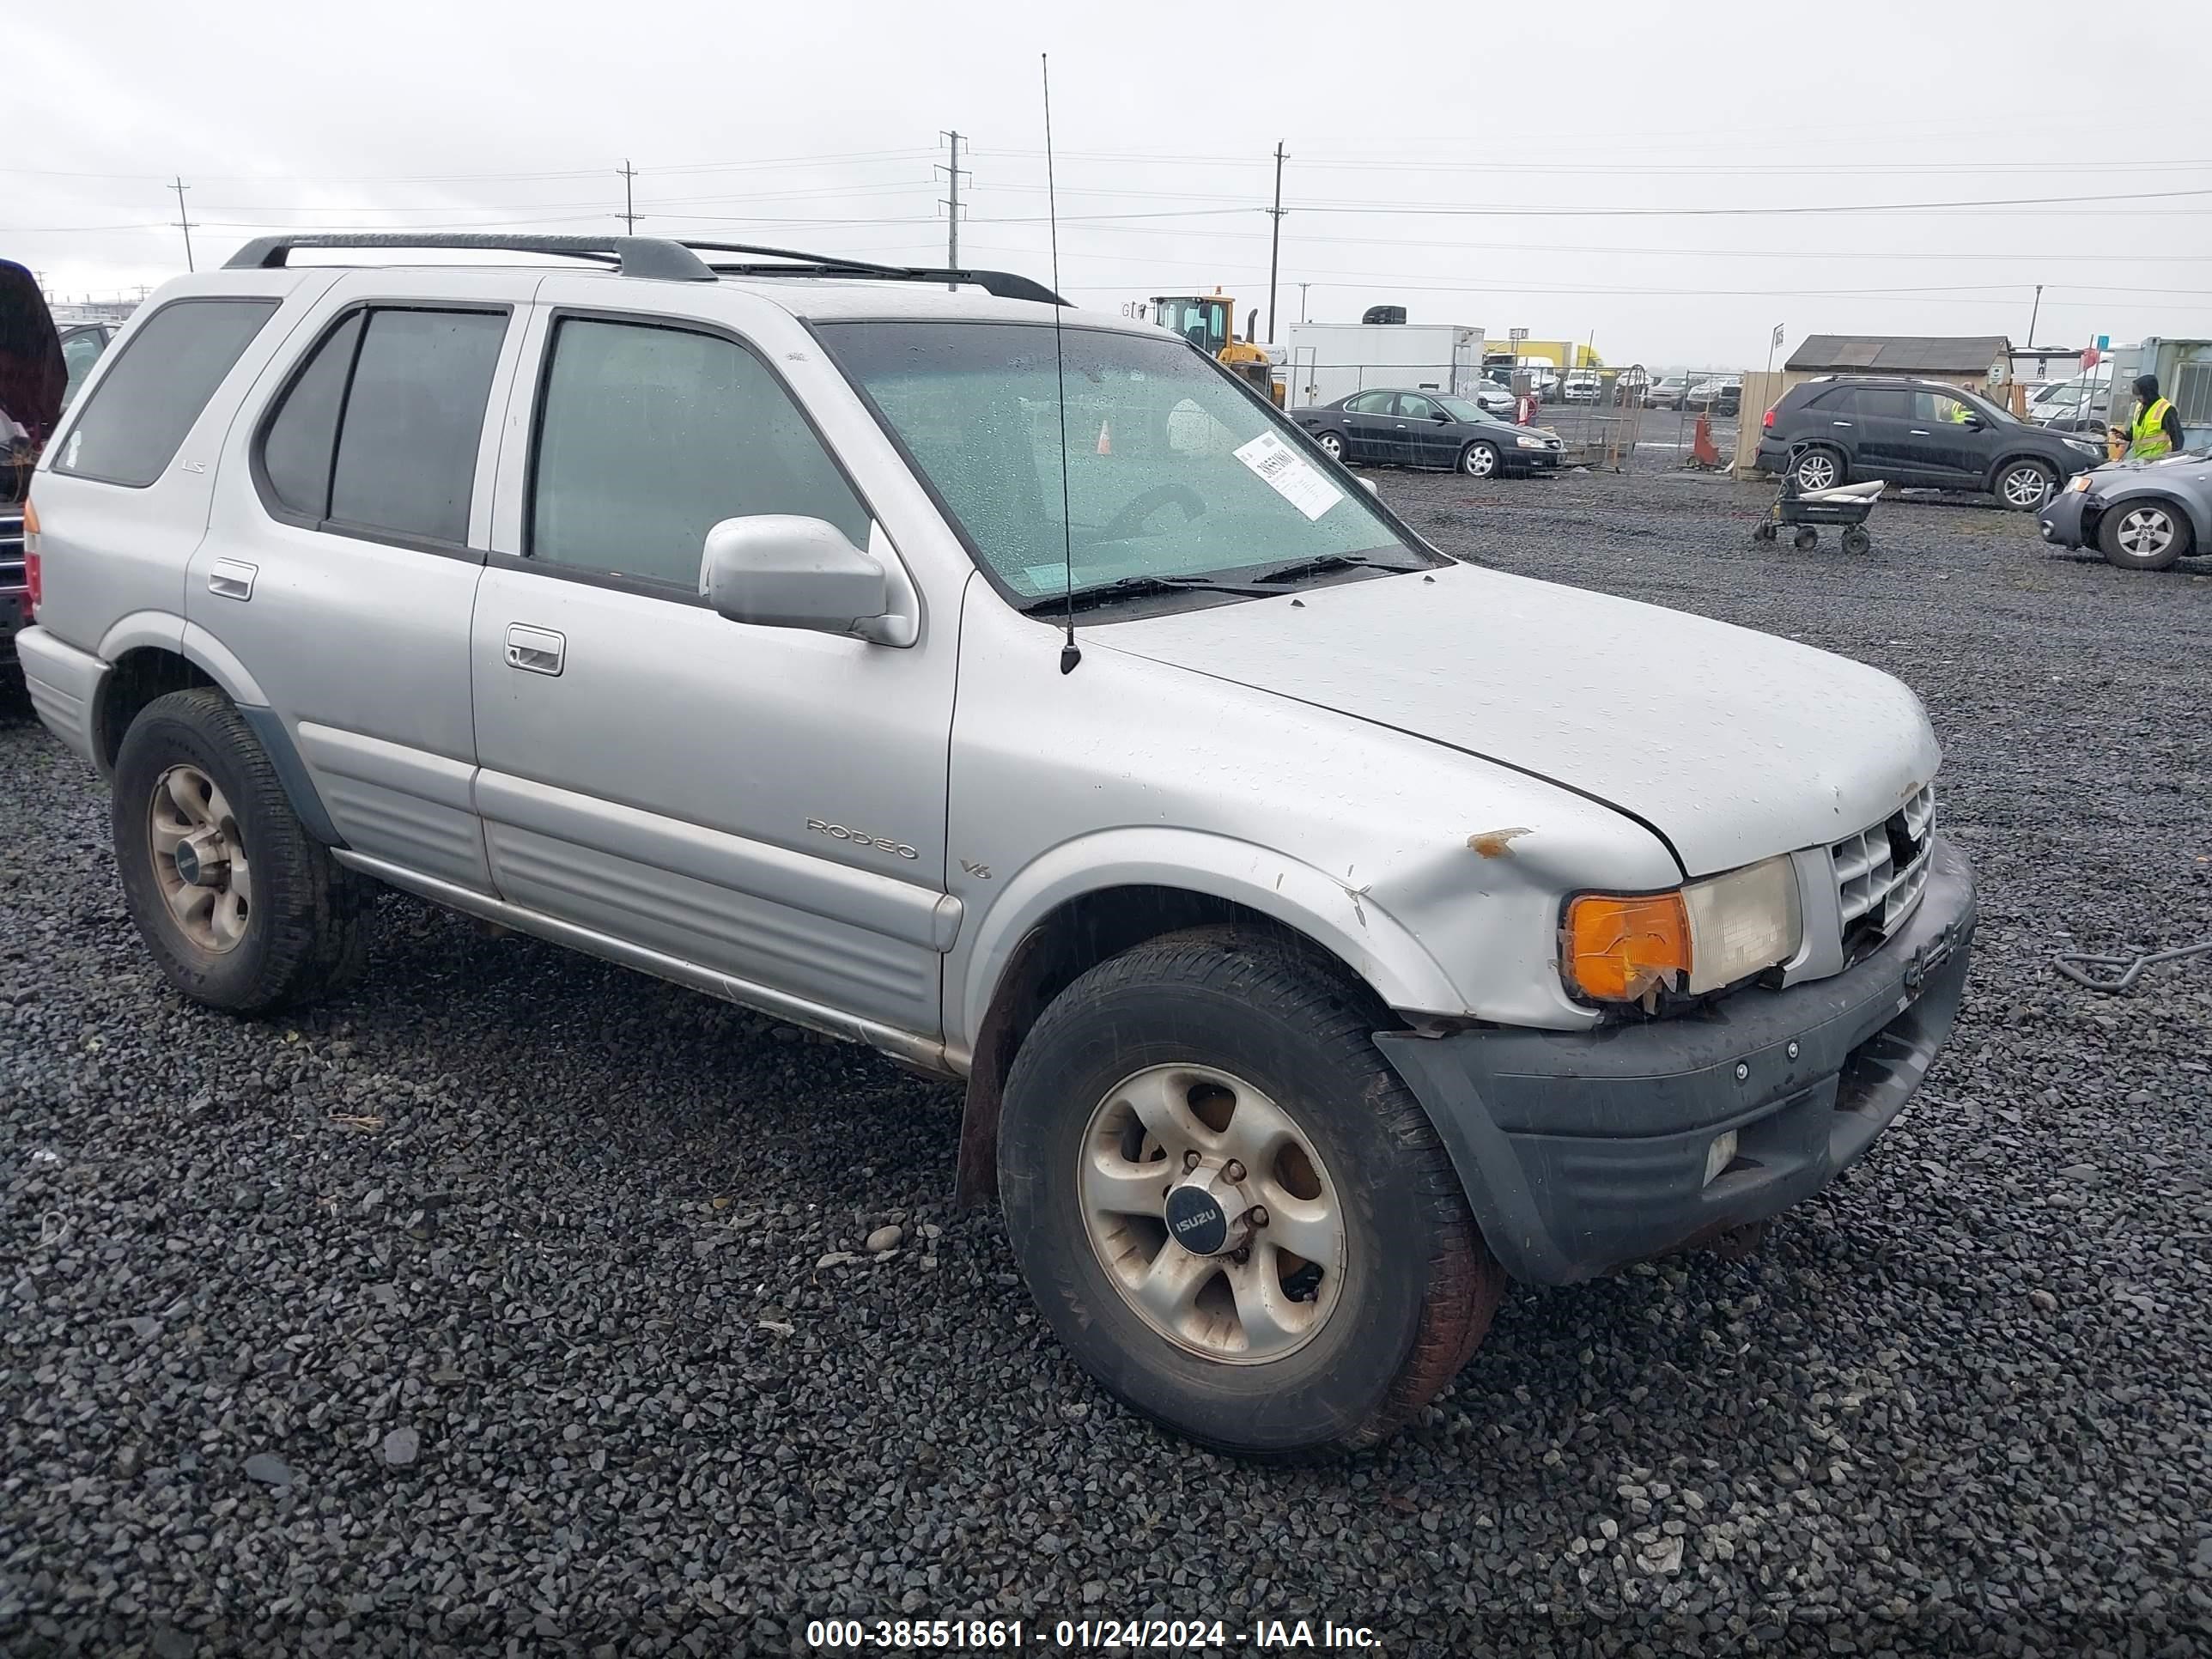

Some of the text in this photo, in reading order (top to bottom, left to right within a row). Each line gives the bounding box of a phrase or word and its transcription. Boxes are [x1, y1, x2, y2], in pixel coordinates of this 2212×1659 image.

[1255, 446, 1296, 479] 38551861
[805, 816, 921, 860] RODEO
[959, 858, 993, 880] V6
[1175, 1208, 1217, 1233] ISUZU
